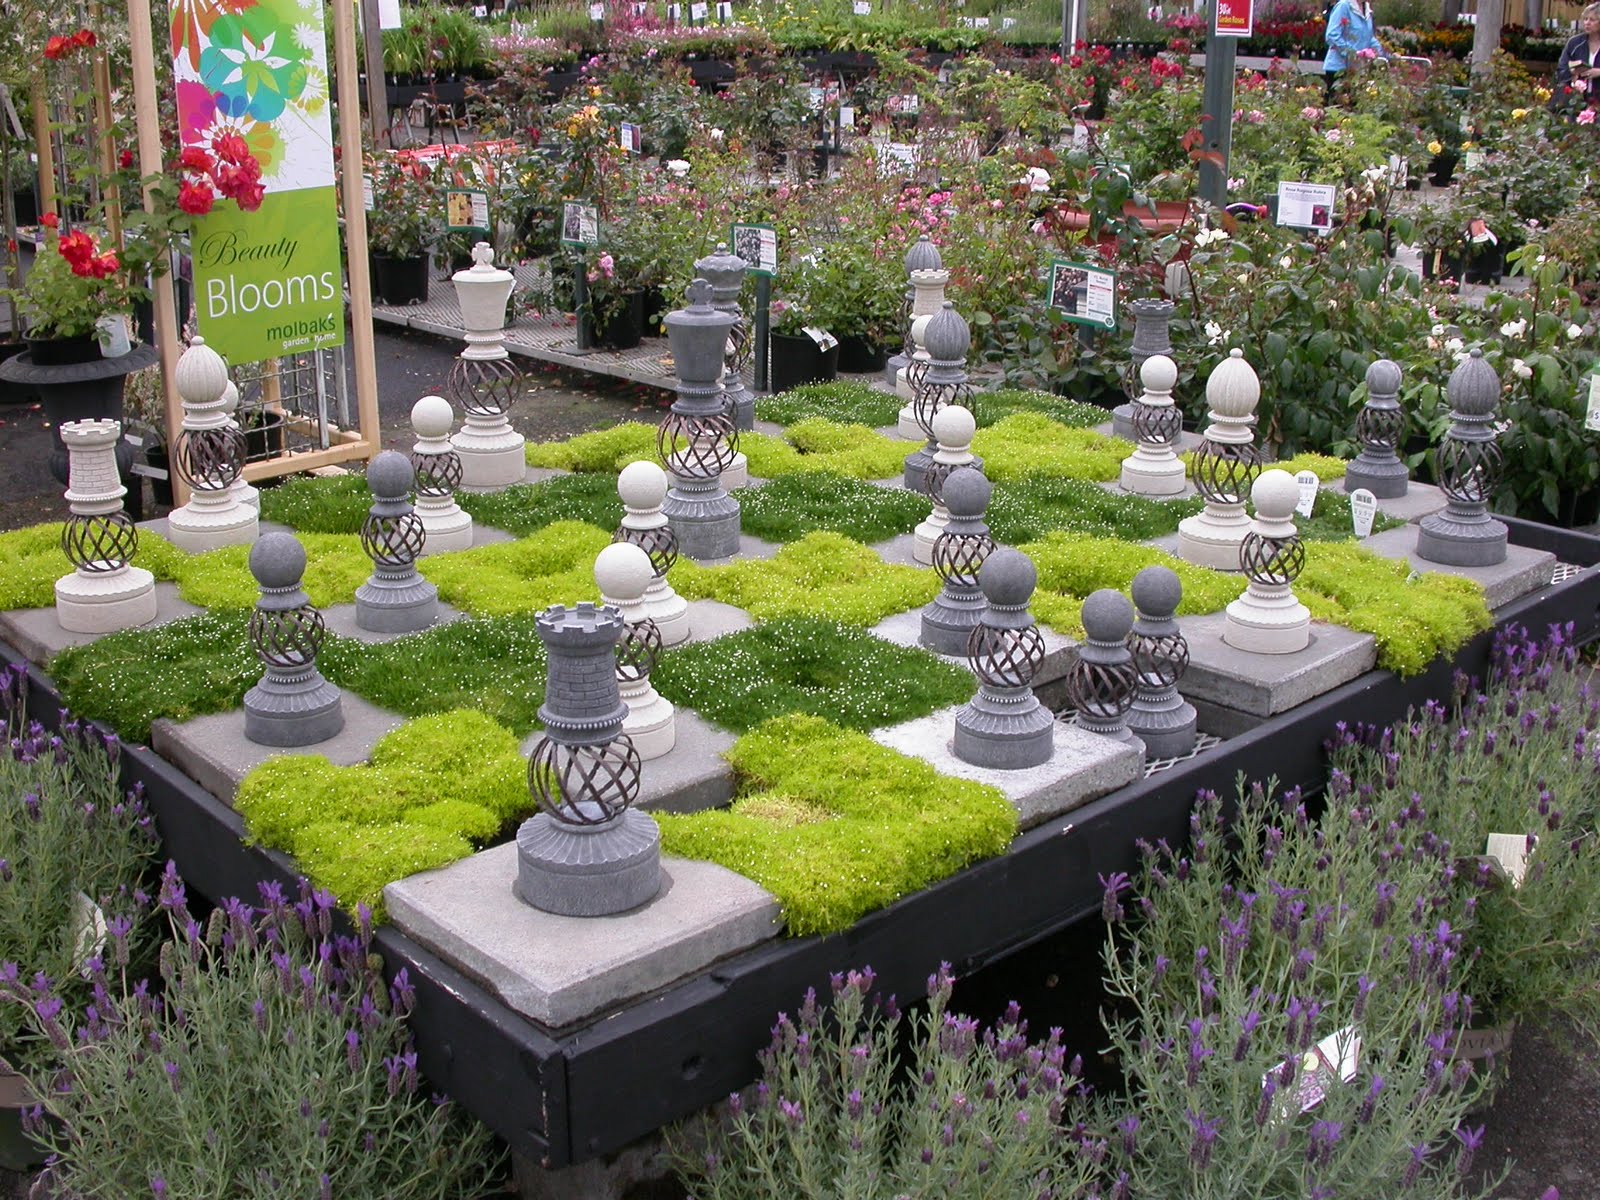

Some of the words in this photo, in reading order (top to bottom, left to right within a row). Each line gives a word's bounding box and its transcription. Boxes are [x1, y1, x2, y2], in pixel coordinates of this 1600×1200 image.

[200, 230, 298, 271] Beauty
[207, 271, 335, 318] Blooms
[282, 337, 309, 349] garden
[314, 332, 336, 343] home
